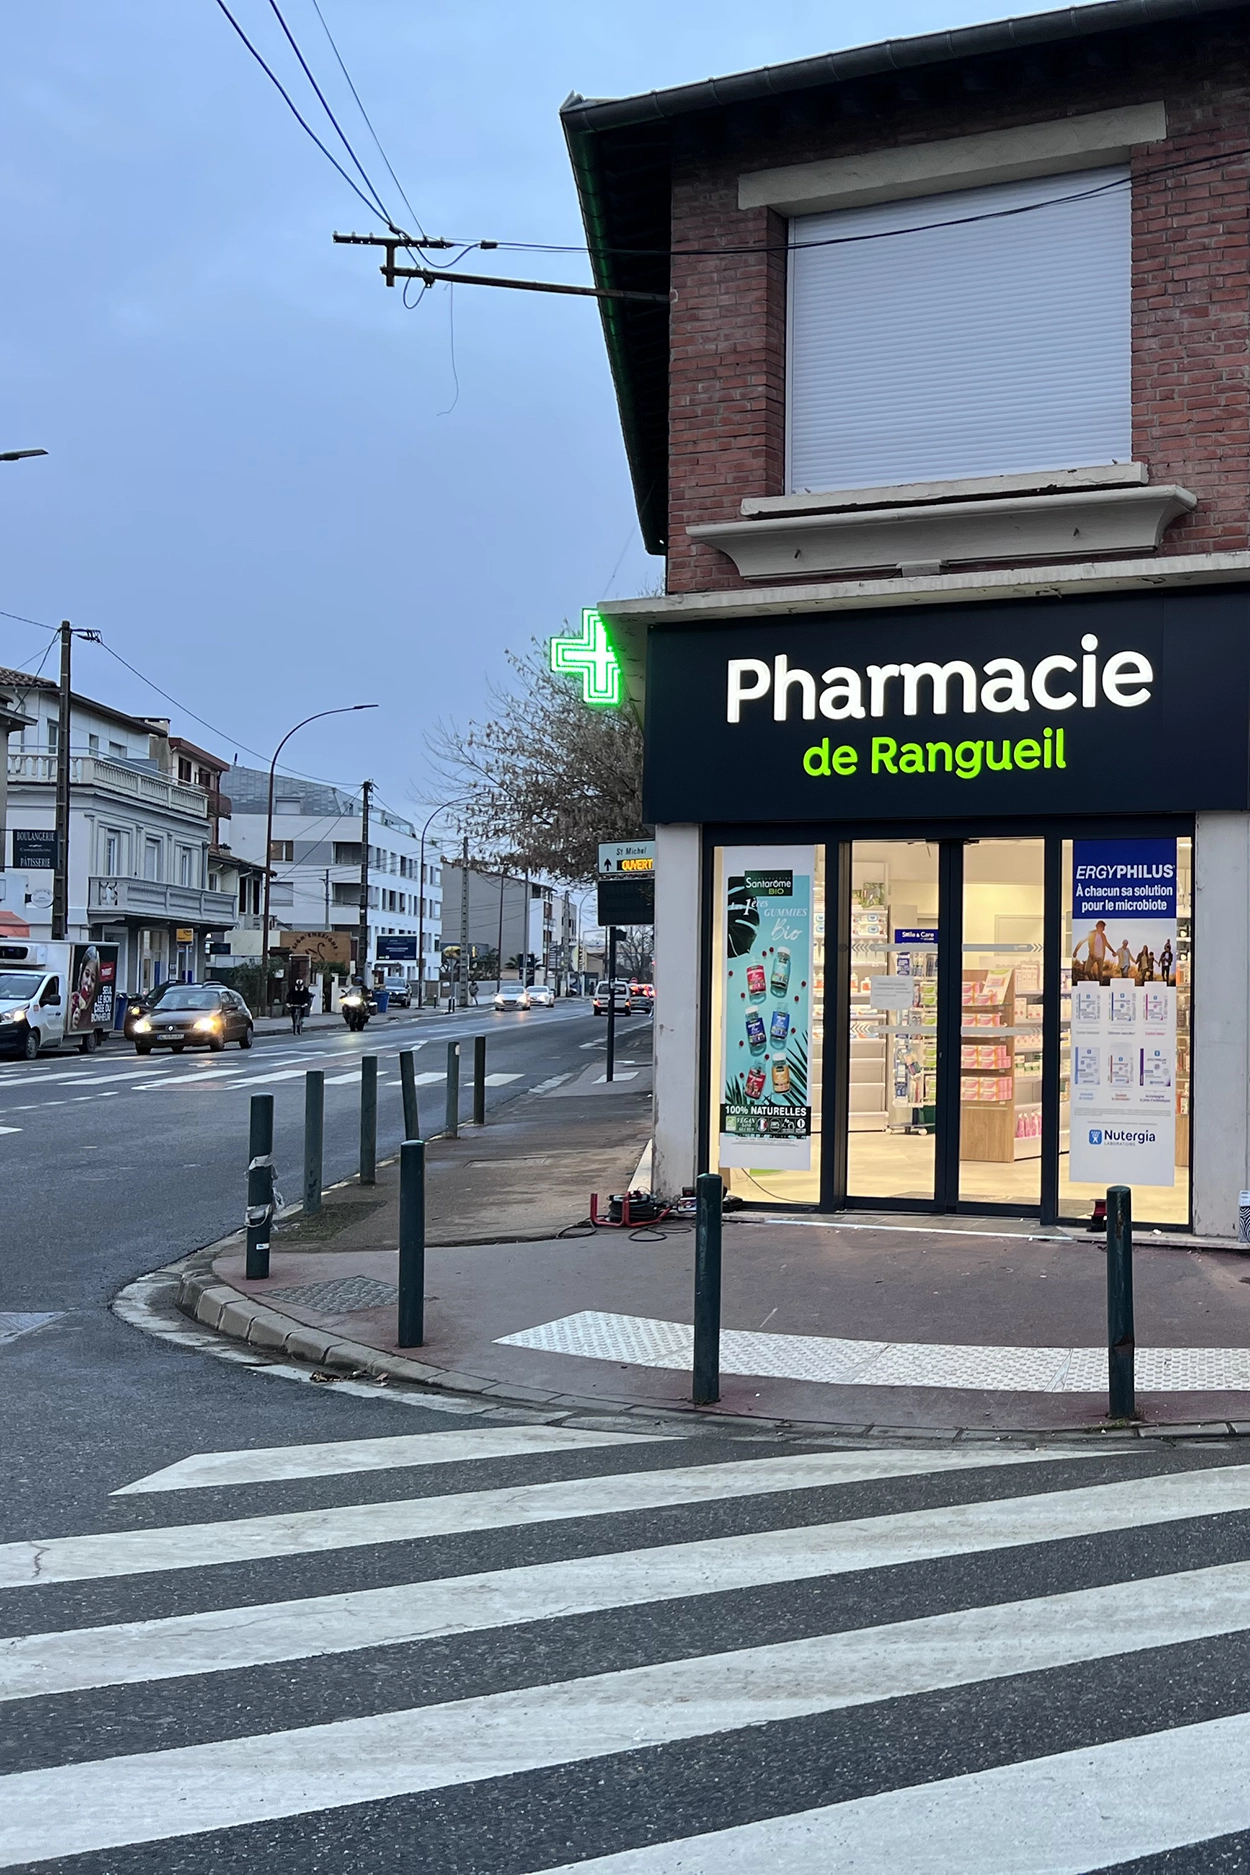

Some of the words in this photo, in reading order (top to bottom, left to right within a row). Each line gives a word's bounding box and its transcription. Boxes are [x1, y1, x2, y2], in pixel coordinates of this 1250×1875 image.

[726, 632, 1154, 724] Pharmacie
[802, 736, 858, 777] de
[870, 726, 1067, 779] Rangueil
[16, 831, 55, 842] BOULANGERIE
[616, 848, 624, 856] St
[626, 846, 647, 855] Michel
[622, 859, 654, 871] OUVERT
[1076, 882, 1084, 897] À
[1084, 885, 1120, 897] chacun
[1120, 887, 1132, 896] sa
[1134, 884, 1172, 896] solution
[764, 908, 808, 917] GUMMIES
[1082, 902, 1104, 914] pour
[1105, 900, 1114, 910] le
[1116, 899, 1167, 910] microbiote
[770, 918, 803, 941] Bio
[725, 1106, 748, 1114] 100%
[750, 1106, 806, 1116] NATURELLES
[1104, 1130, 1156, 1144] Nutergia
